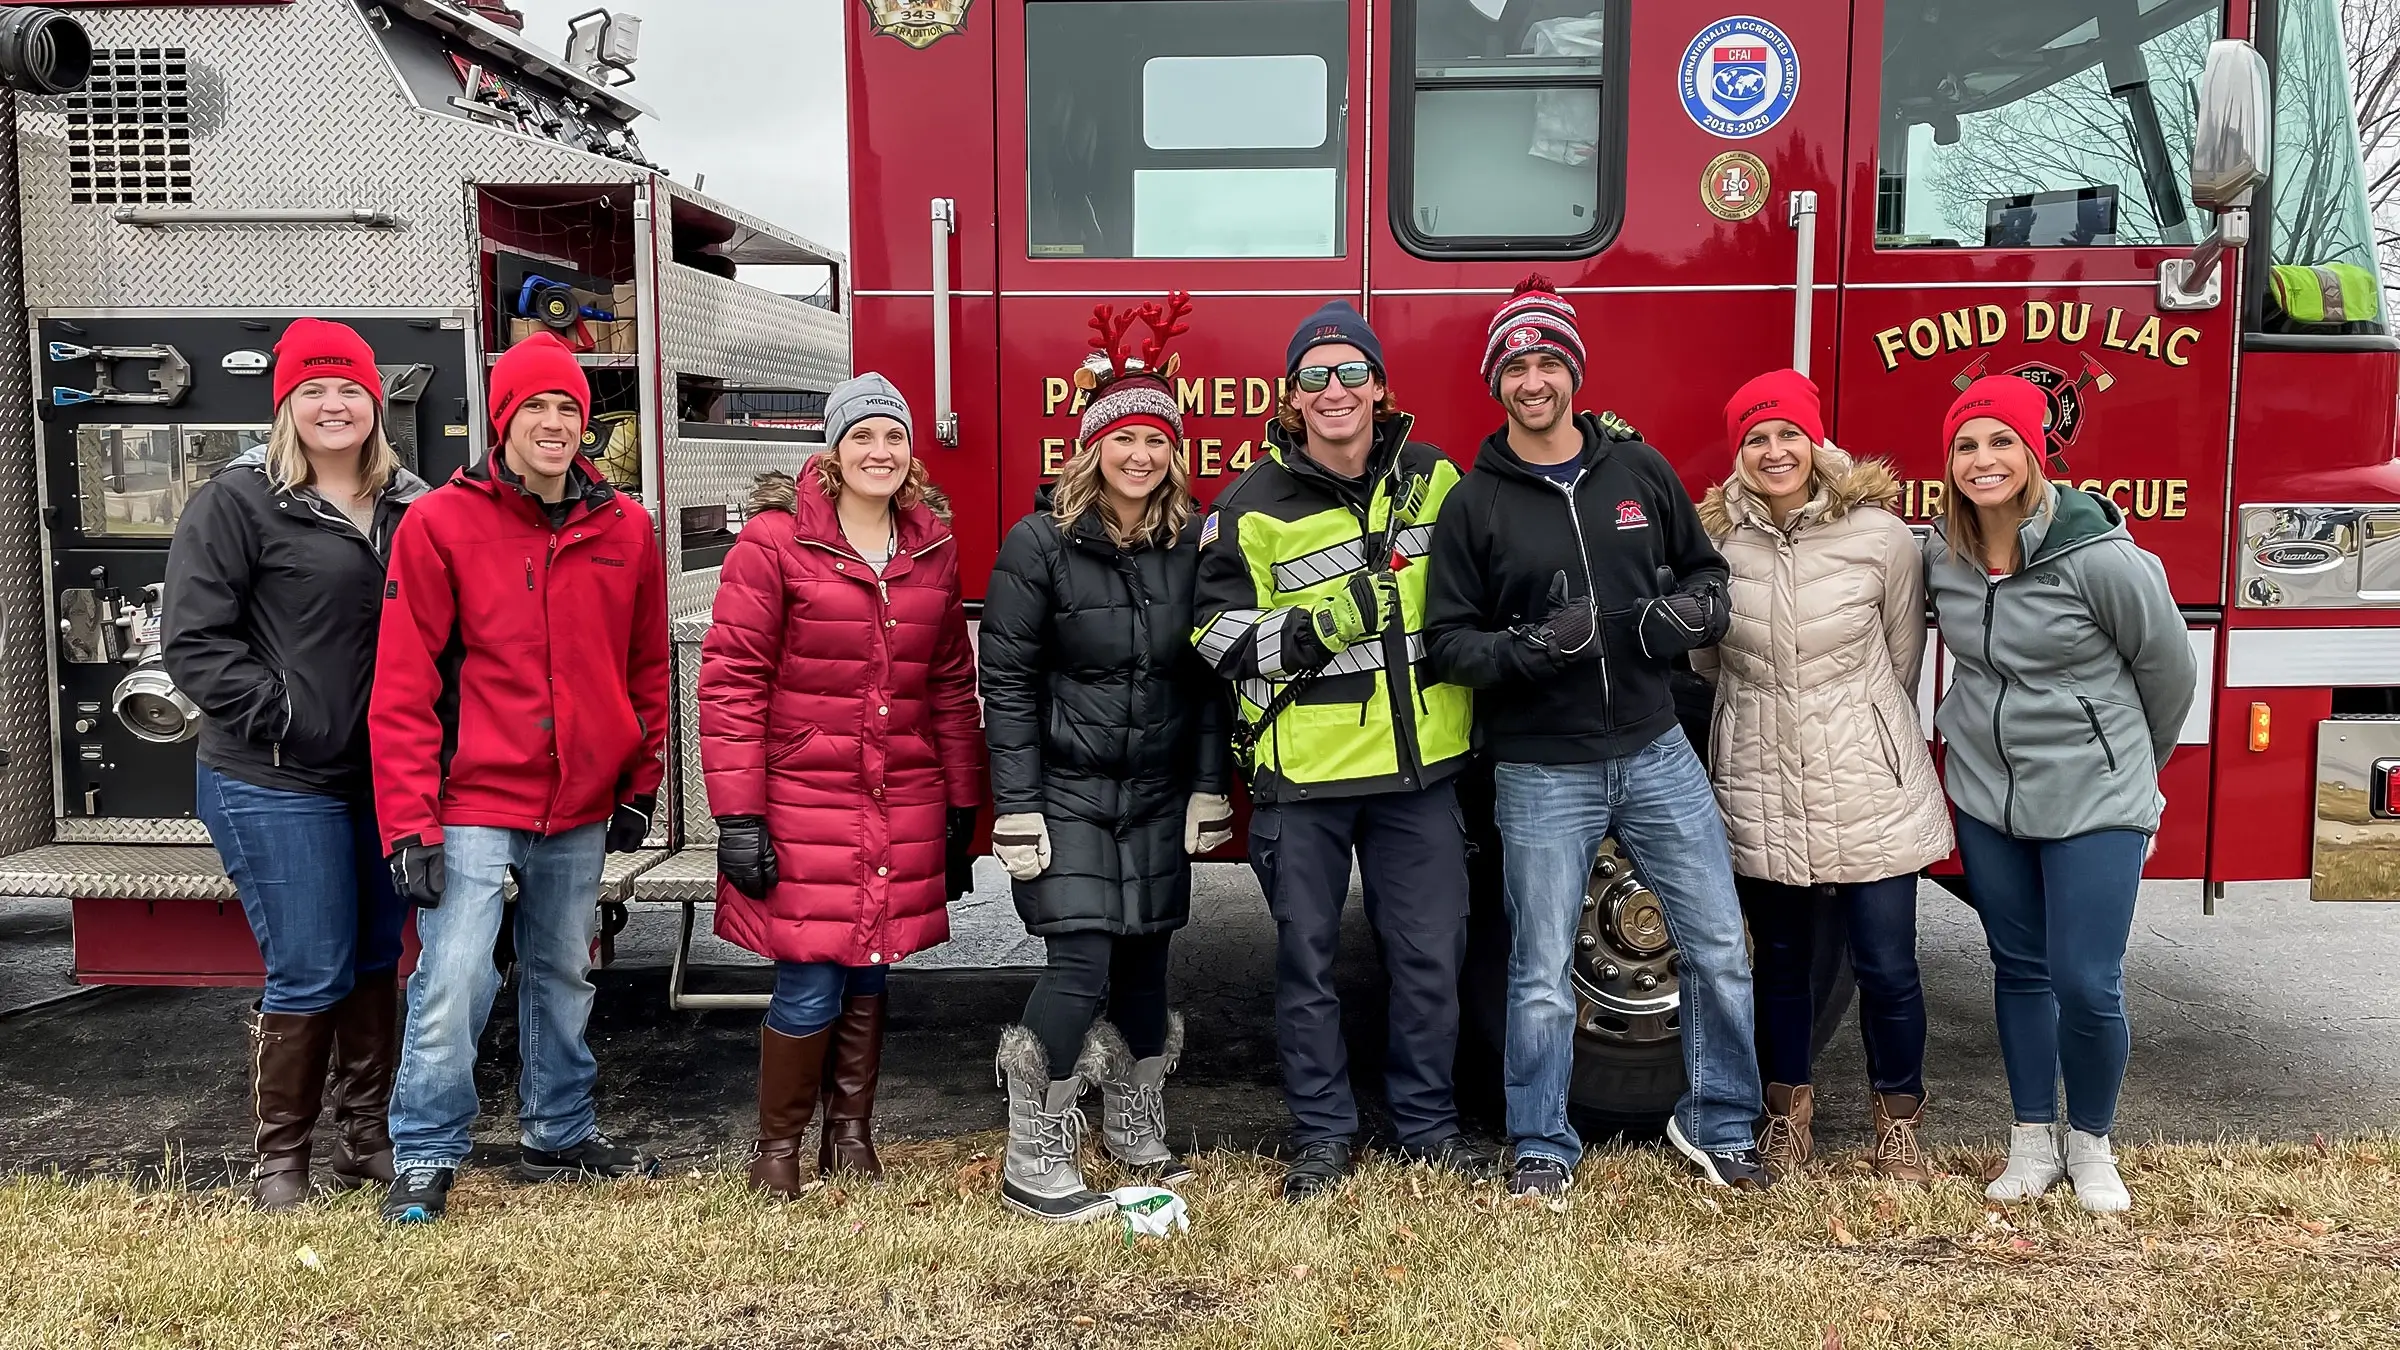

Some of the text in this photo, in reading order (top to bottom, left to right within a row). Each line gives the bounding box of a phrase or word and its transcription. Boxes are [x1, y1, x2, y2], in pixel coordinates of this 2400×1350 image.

[900, 10, 936, 20] 343
[894, 25, 944, 38] TRADITION
[1684, 21, 1794, 100] INTERNATIONALLY ACCREDITED AGENCY
[1728, 49, 1751, 60] CFAI
[1703, 114, 1770, 134] 2015-2020
[1721, 178, 1750, 192] ISO
[1719, 209, 1741, 218] CLASS
[1748, 200, 1762, 213] CITY
[1875, 301, 2202, 370] FOND DU LAC
[2273, 549, 2326, 563] Quantum
